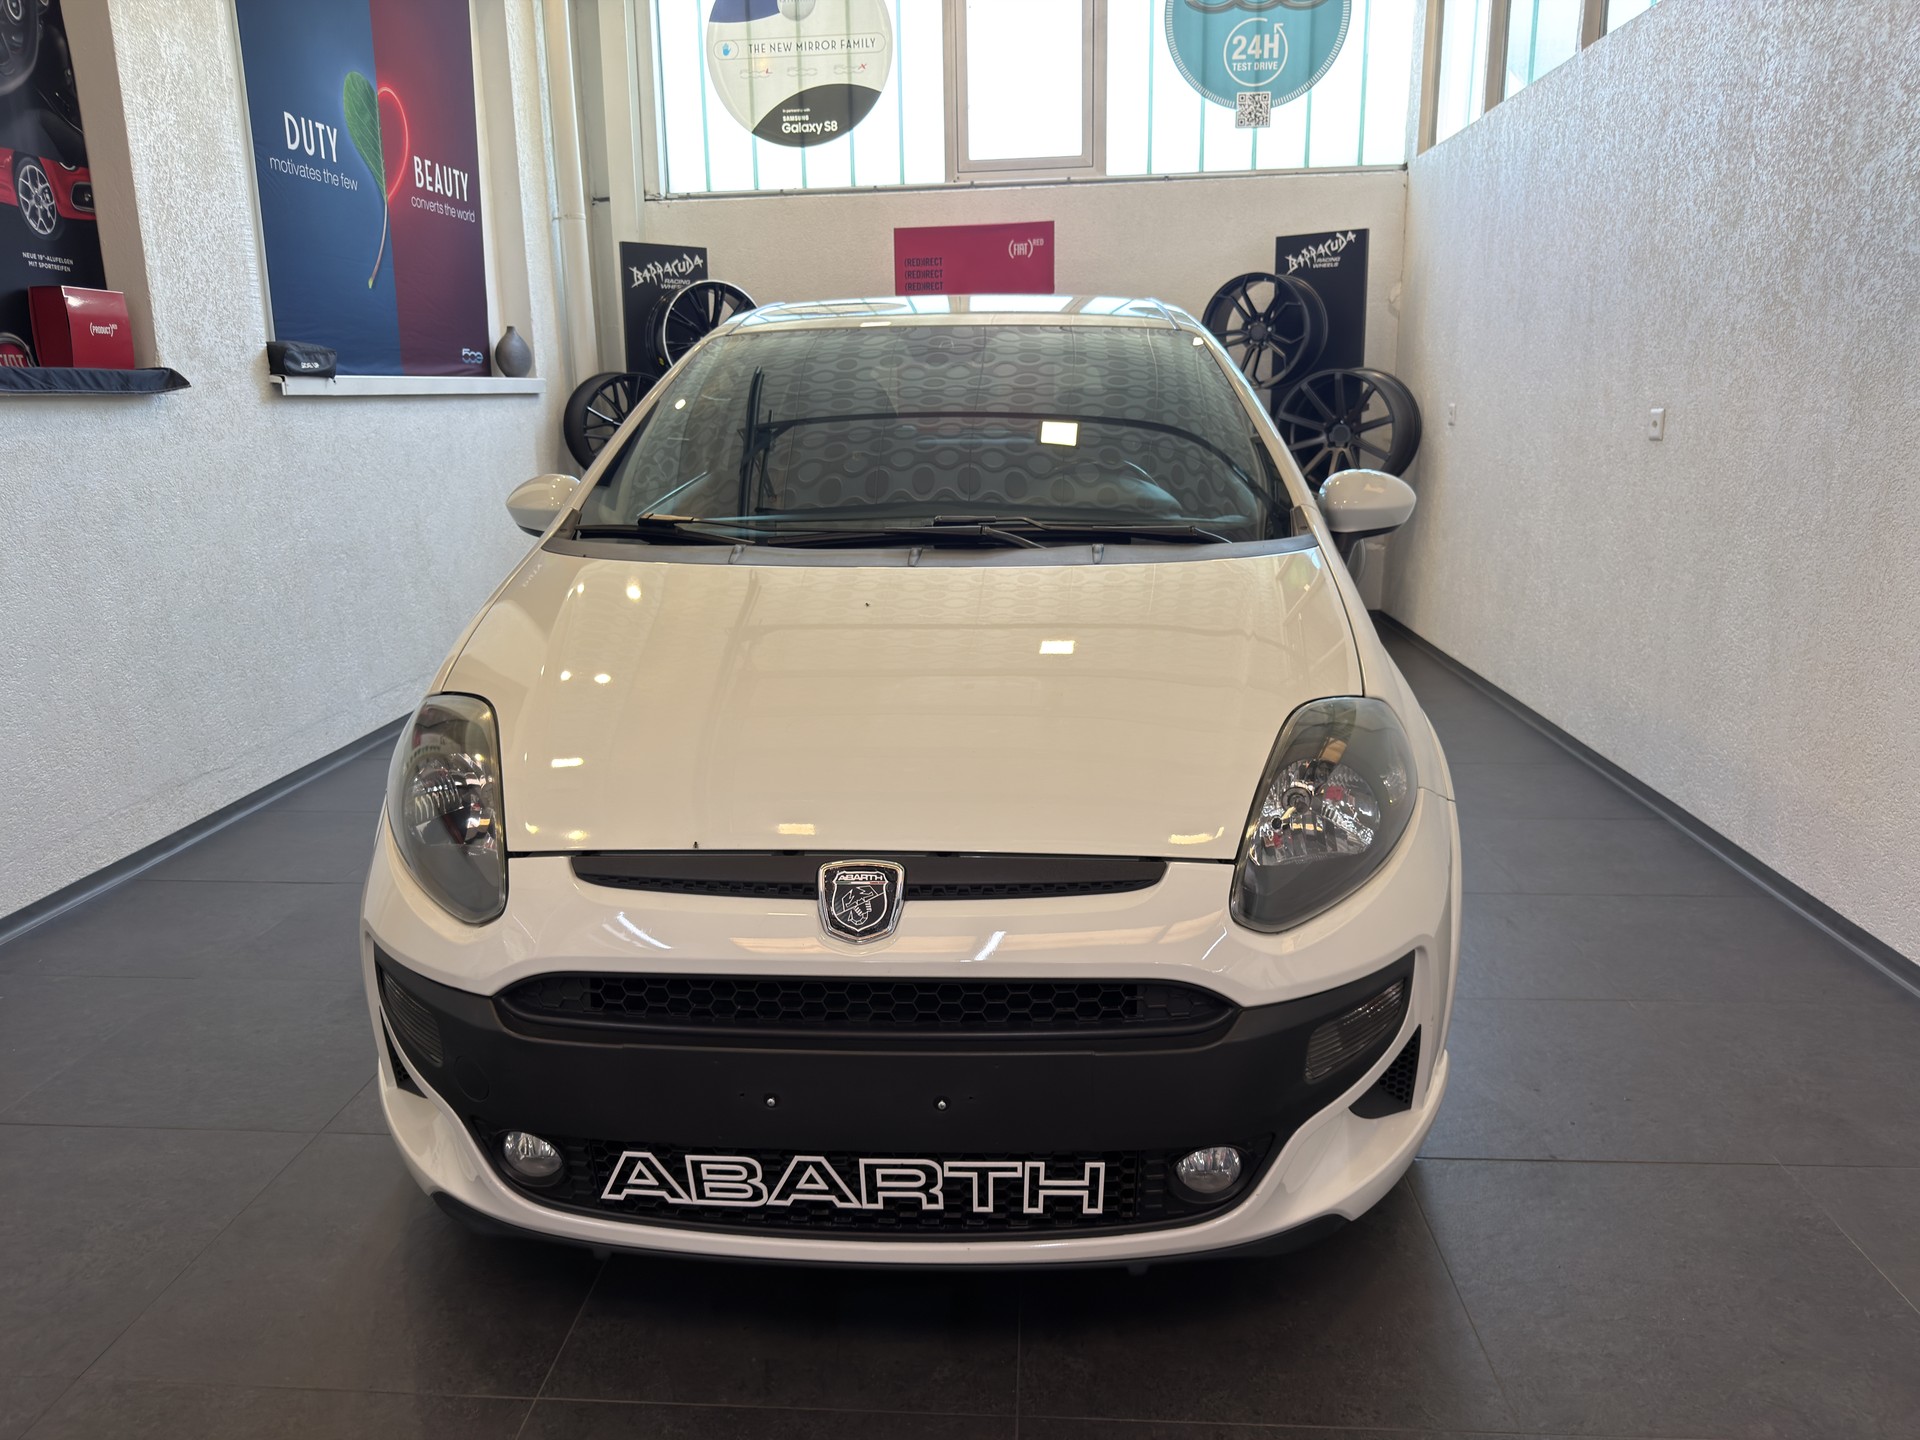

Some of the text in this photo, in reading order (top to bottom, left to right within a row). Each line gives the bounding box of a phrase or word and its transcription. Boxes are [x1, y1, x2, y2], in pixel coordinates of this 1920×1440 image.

[749, 37, 876, 54] THE NEW MIRROR FAMILY
[1231, 33, 1280, 60] 24H
[1232, 61, 1278, 71] TEST DRIVE
[283, 111, 337, 163] DUTY
[781, 120, 838, 135] Galaxy S8
[269, 157, 358, 191] motivates the few
[413, 155, 468, 202] BEAUTY
[411, 196, 476, 223] converts the world
[22, 251, 37, 260] NEUE
[1285, 230, 1357, 276] BARRACUDA
[38, 262, 71, 272] SPORTREIFEN
[628, 253, 704, 288] BARRACUDA
[601, 1151, 1105, 1214] ABARTH
